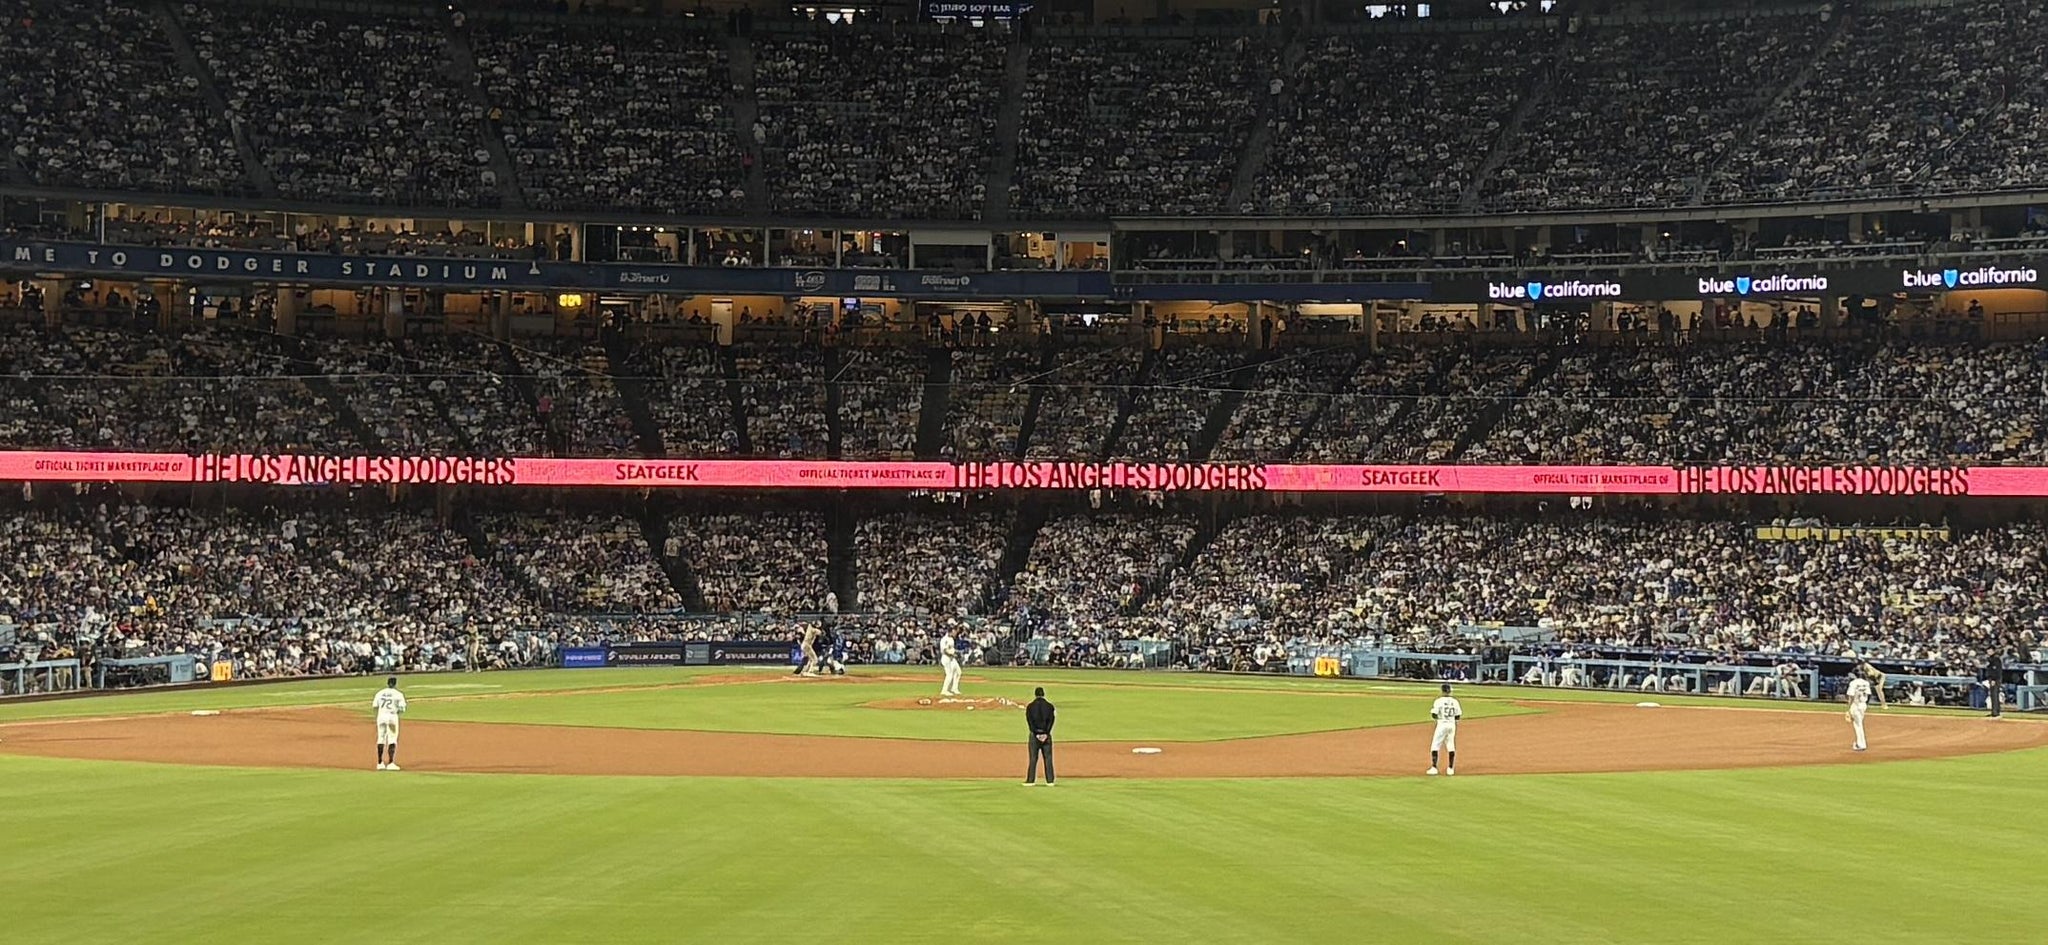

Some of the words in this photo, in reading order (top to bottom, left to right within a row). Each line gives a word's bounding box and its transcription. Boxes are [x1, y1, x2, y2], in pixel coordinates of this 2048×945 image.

[15, 247, 55, 262] ME
[88, 251, 127, 266] TO
[160, 253, 309, 274] DODGER
[341, 261, 508, 281] STADIUM
[1698, 276, 1735, 294] blue
[1751, 274, 1828, 293] california
[1903, 269, 1942, 287] blue
[1959, 265, 2037, 285] california
[1489, 282, 1526, 299] blue
[1543, 280, 1622, 298] california
[34, 460, 73, 472] OFFICIAL
[75, 460, 106, 472] TICKET
[107, 460, 169, 473] MARKETPLACE
[171, 462, 184, 473] OF
[188, 453, 232, 483] THE
[235, 453, 282, 484] LOS
[285, 454, 394, 485] ANGELES
[397, 455, 516, 486] DODGERS
[615, 463, 700, 481] SEATGEEK
[799, 469, 838, 480] OFFICIAL
[839, 469, 870, 480] TICKET
[871, 469, 932, 480] MARKETPLACE
[934, 470, 946, 480] OF
[950, 461, 994, 489] THE
[998, 461, 1043, 489] LOS
[1048, 461, 1151, 490] ANGELES
[1154, 462, 1268, 491] DODGERS
[1361, 469, 1441, 487] SEATGEEK
[1533, 474, 1569, 484] OFFICIAL
[1571, 474, 1599, 484] TICKET
[1601, 474, 1657, 485] MARKETPLACE
[1659, 475, 1669, 485] OF
[1672, 465, 1714, 494] THE
[1718, 465, 1758, 494] LOS
[1762, 465, 1858, 494] ANGELES
[1861, 465, 1970, 495] DODGERS
[380, 697, 393, 710] 72
[1443, 706, 1456, 719] 50
